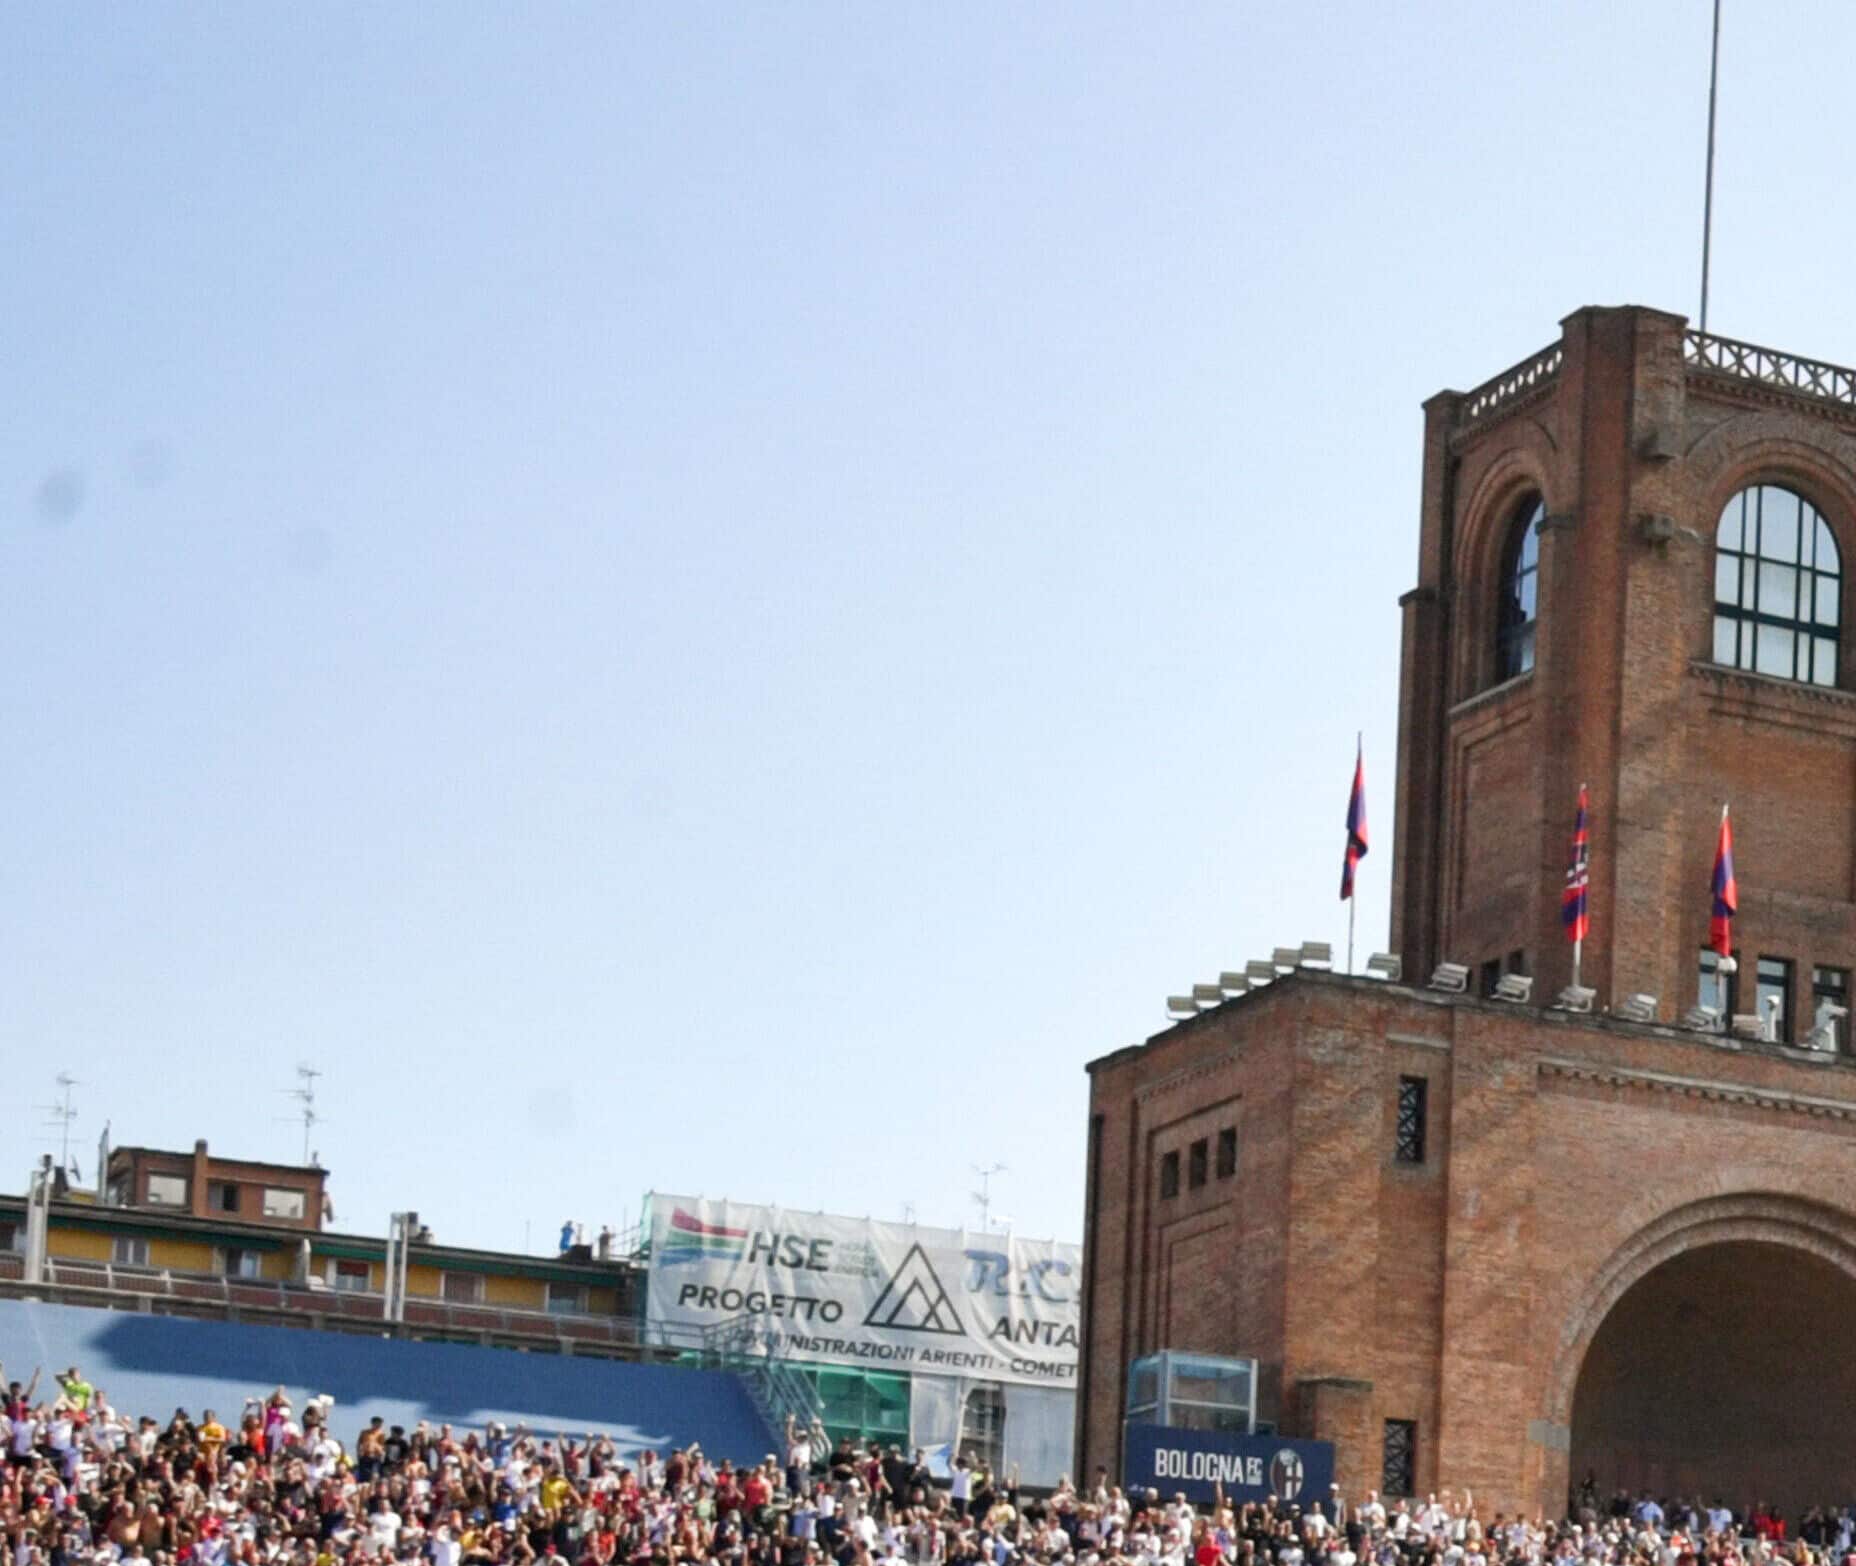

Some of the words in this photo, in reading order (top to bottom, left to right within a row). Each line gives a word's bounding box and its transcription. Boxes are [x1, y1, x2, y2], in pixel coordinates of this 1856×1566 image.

[748, 1231, 834, 1272] HSE
[677, 1283, 844, 1324] PROGETTO
[919, 1348, 995, 1371] ARIENTI
[1155, 1448, 1245, 1485] BOLOGNA
